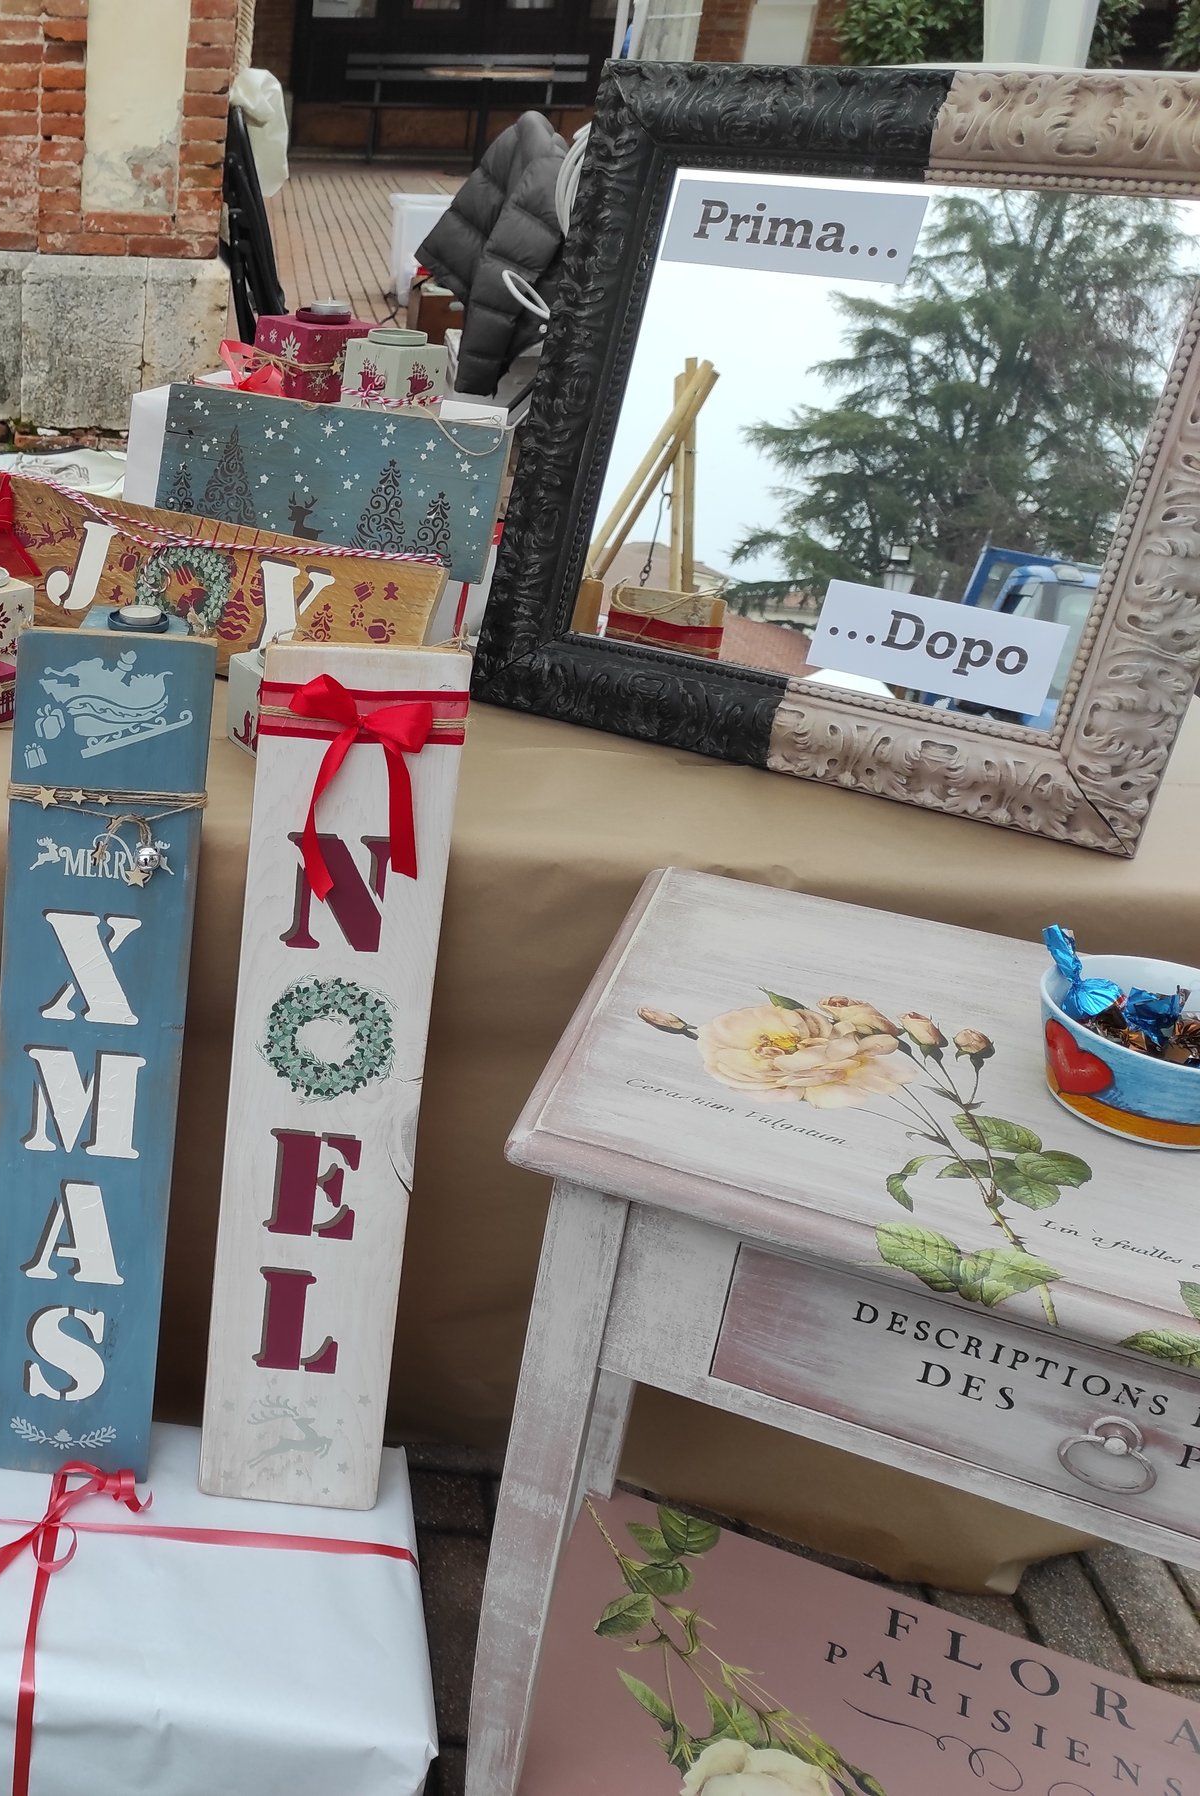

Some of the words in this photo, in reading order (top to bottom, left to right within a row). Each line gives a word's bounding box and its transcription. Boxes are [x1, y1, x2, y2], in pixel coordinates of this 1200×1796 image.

[692, 198, 898, 259] Prima...
[828, 608, 1030, 676] ...Dopo
[21, 908, 147, 1401] XMAS
[852, 1300, 1169, 1415] DESCRIPTIONS
[916, 1360, 1016, 1410] DES
[884, 1606, 1200, 1755] FLORA
